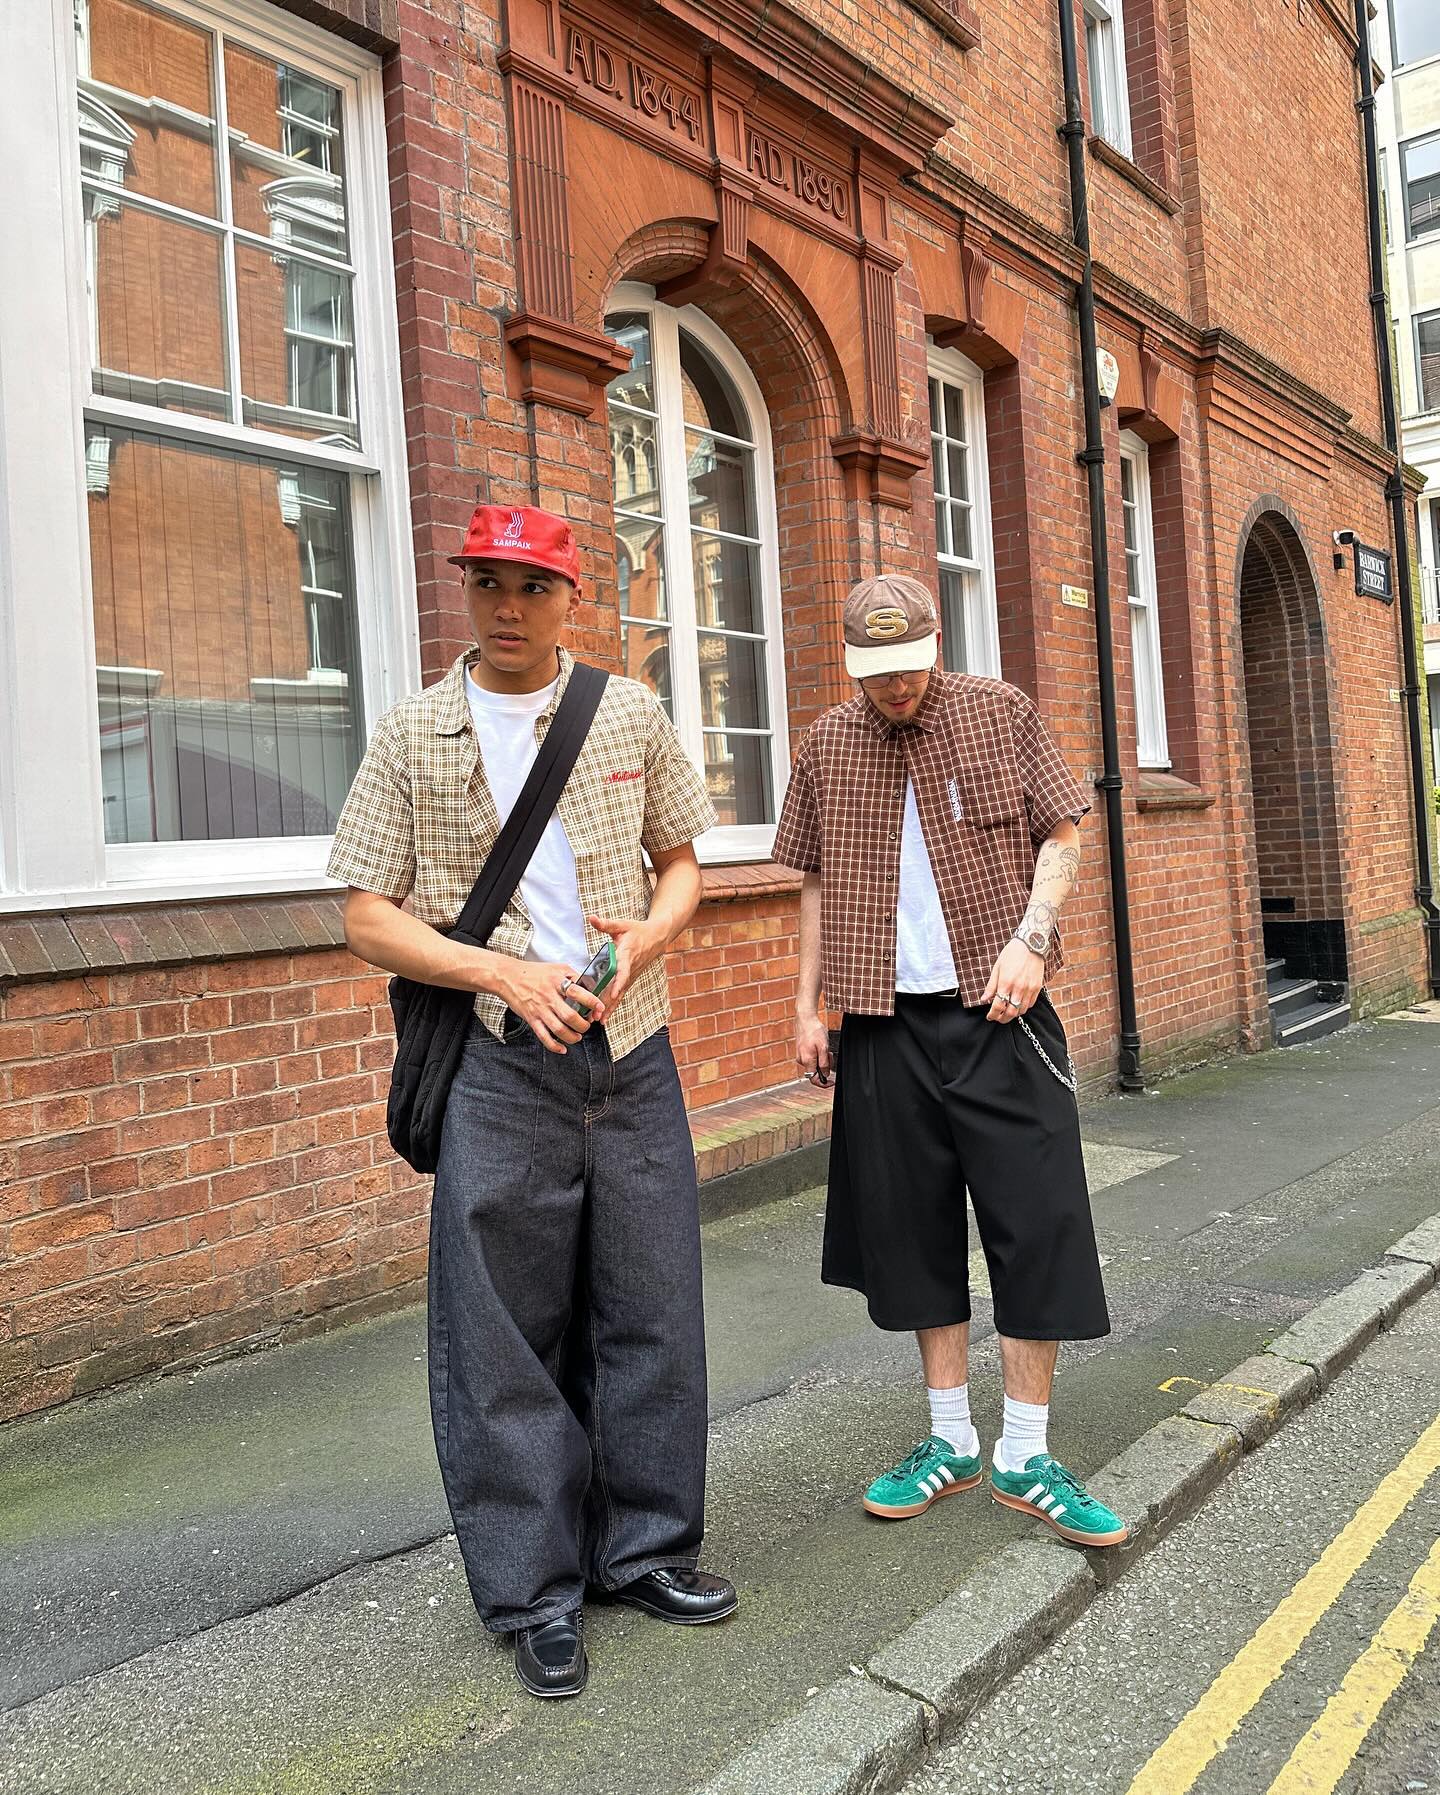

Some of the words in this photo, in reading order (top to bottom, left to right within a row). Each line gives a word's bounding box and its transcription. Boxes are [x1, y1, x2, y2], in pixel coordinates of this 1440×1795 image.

[628, 61, 700, 141] 1844
[791, 155, 849, 219] 1890
[493, 538, 532, 550] SAMPAIX
[1359, 552, 1386, 575] BARWICK
[1363, 570, 1384, 591] STREET
[865, 607, 909, 639] S
